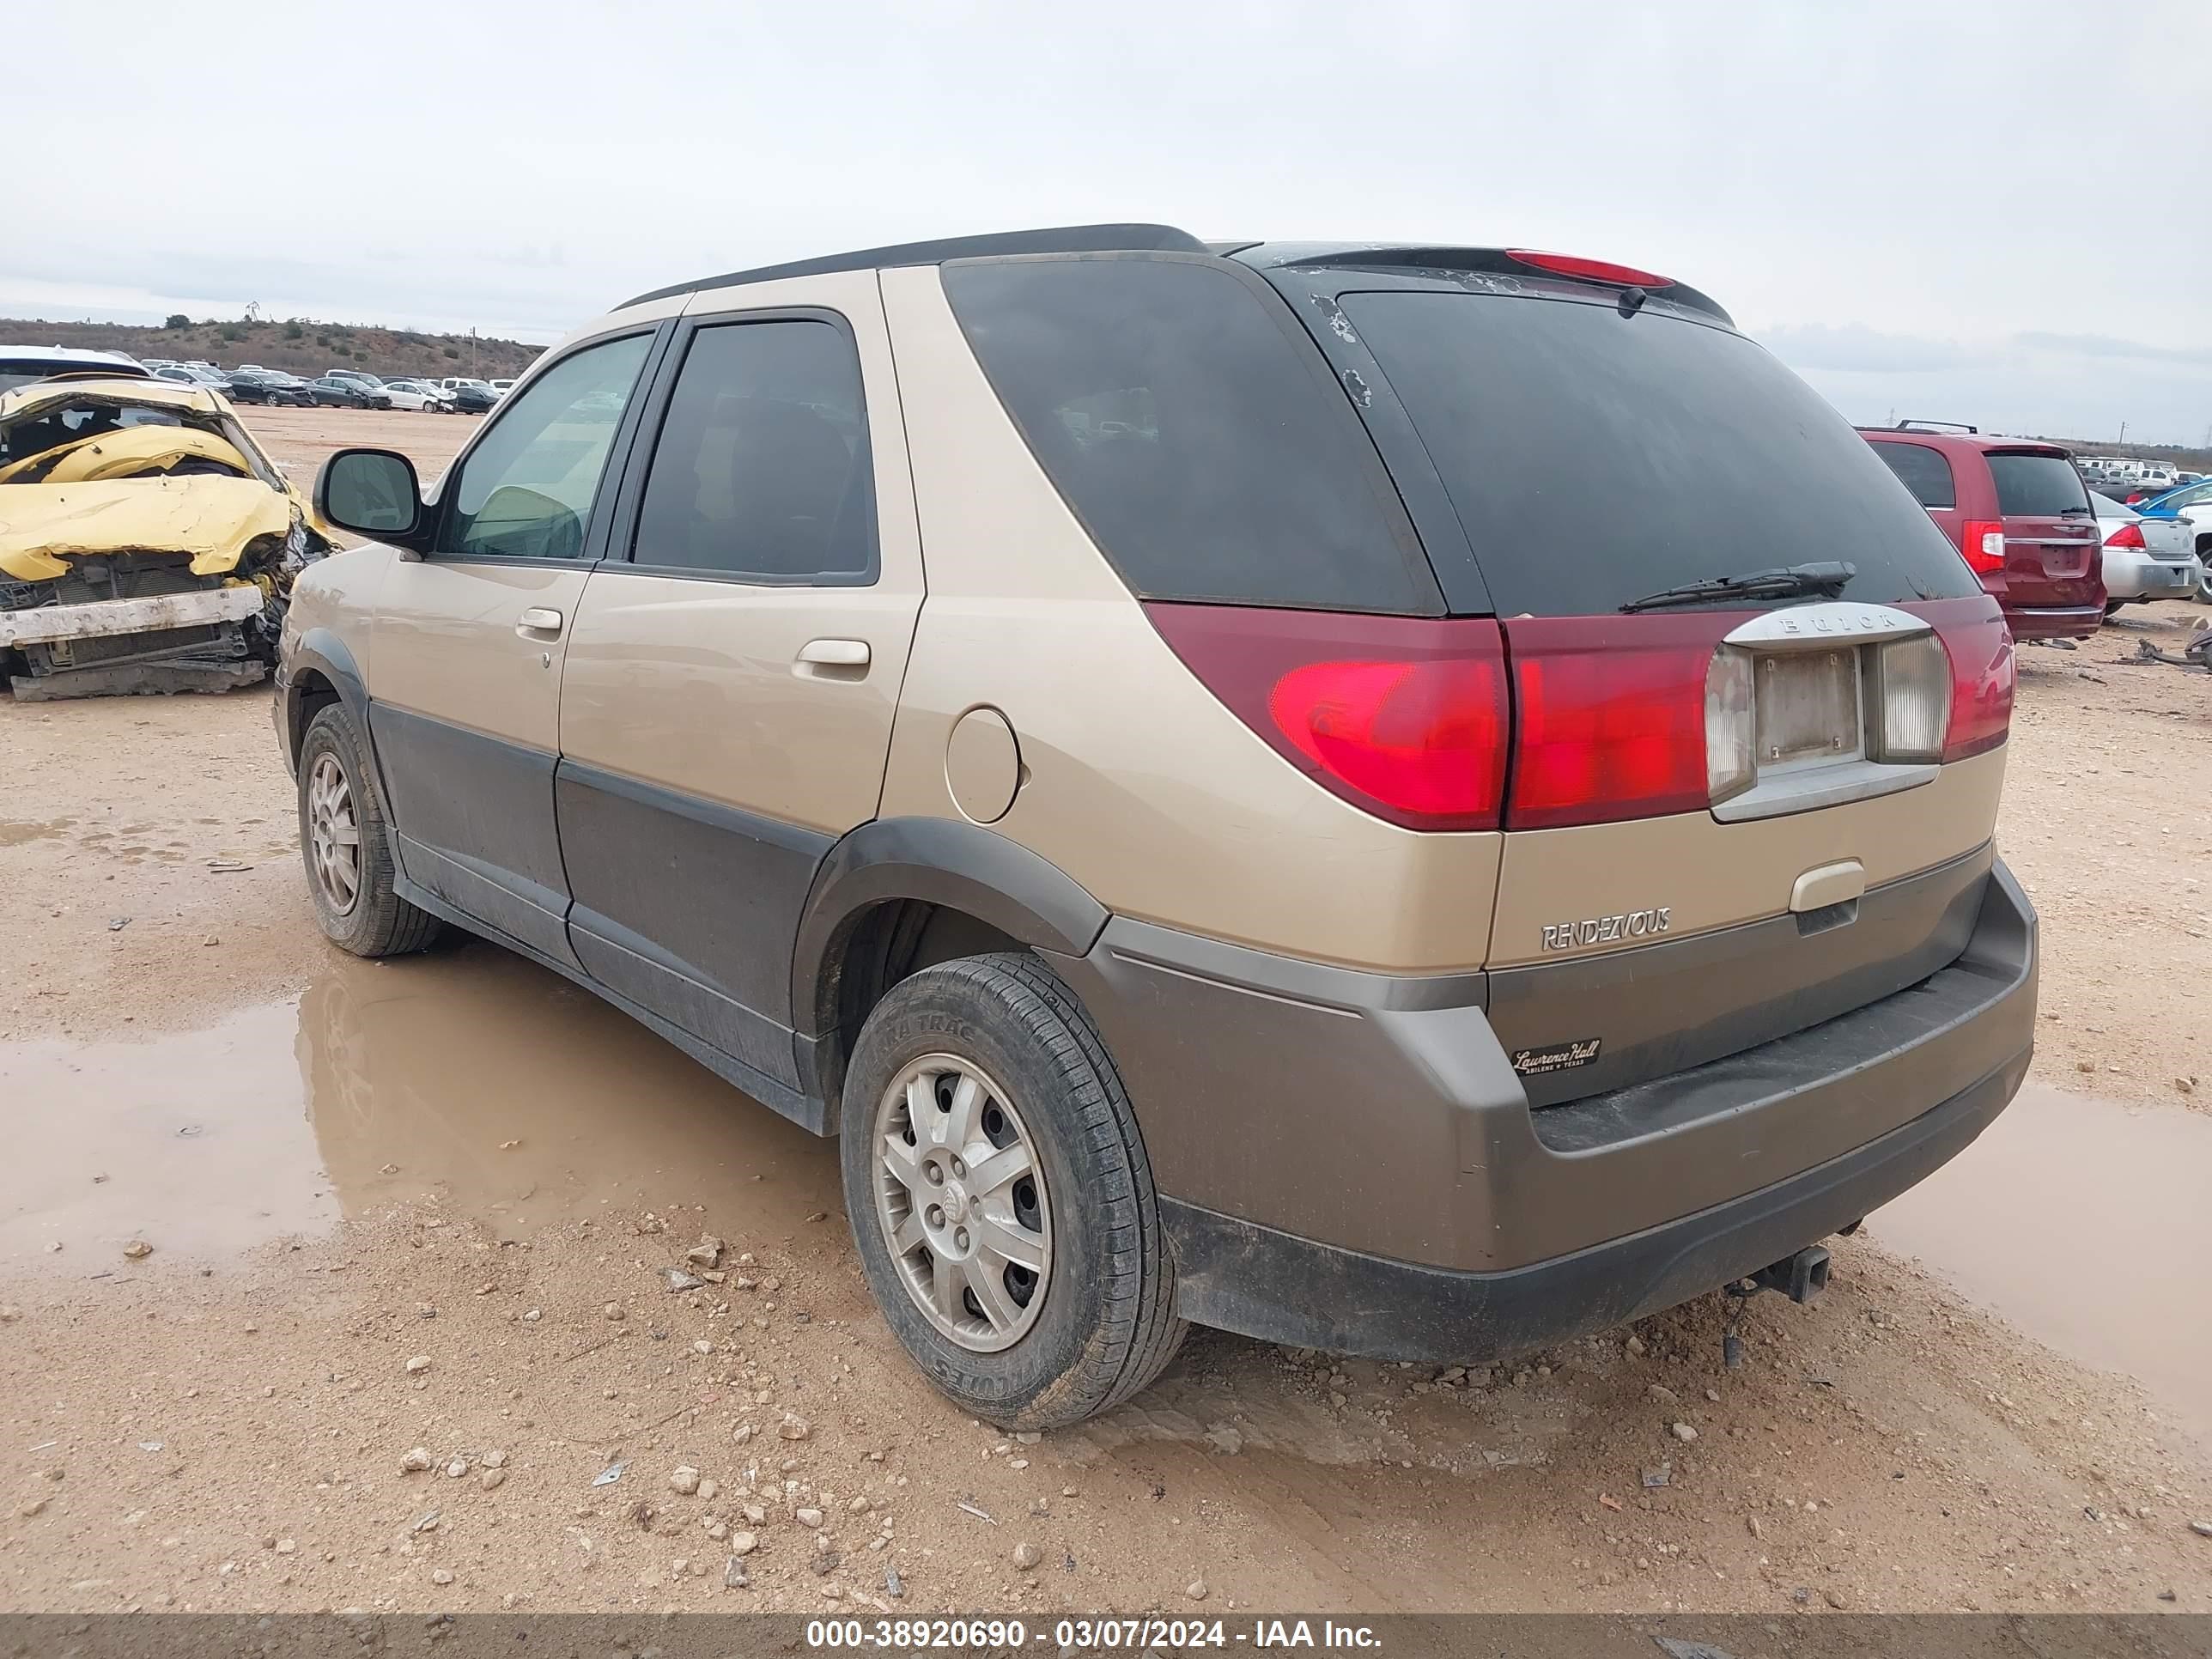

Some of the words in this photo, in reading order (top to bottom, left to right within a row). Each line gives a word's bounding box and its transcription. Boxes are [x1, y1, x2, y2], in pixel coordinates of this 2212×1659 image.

[1779, 614, 1895, 634] BUICK
[1541, 907, 1671, 951] RENDEZVOUS
[915, 1013, 976, 1046] TRAC
[1514, 1050, 1570, 1071] Lawrence
[1569, 1040, 1601, 1061] Hall
[1525, 1065, 1554, 1075] ABILENE
[1564, 1059, 1584, 1068] TEXAS
